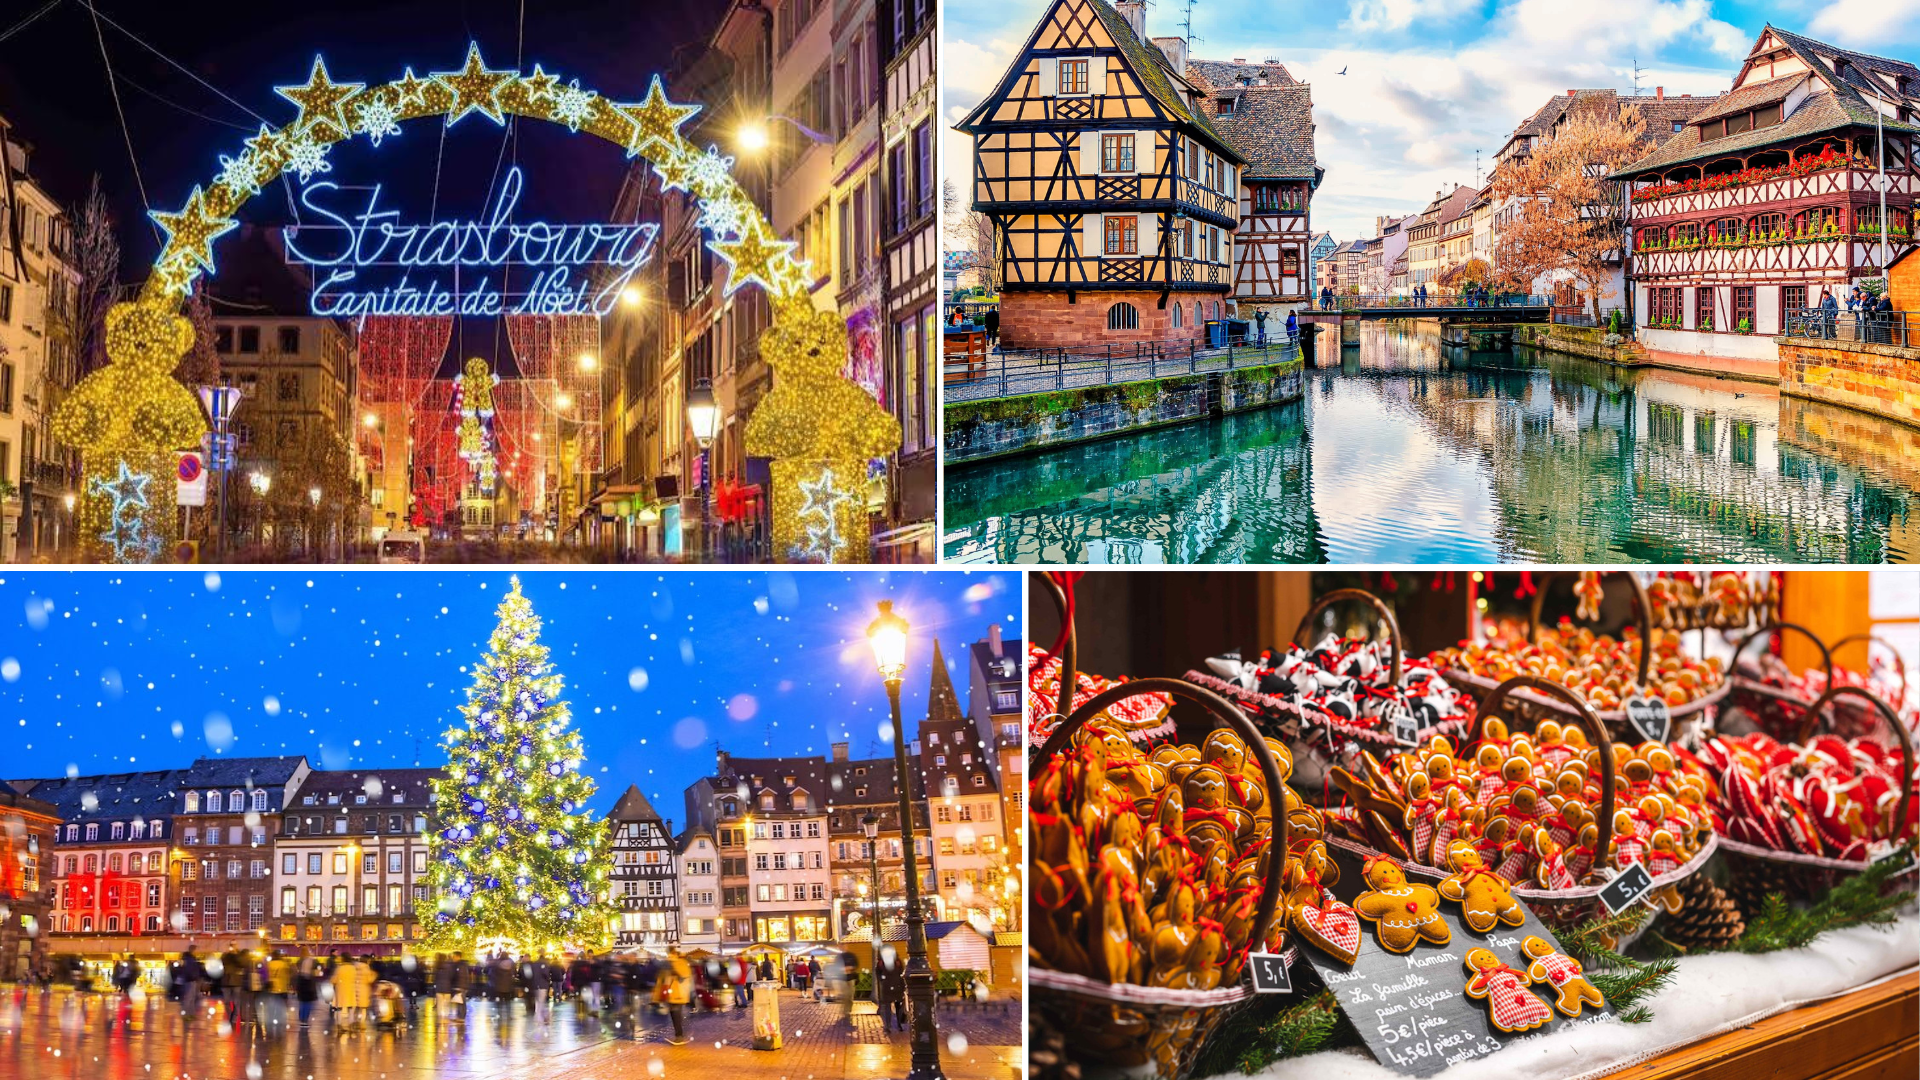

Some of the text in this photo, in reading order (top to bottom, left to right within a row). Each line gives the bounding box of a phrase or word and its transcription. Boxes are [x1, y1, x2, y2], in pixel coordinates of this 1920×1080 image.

[283, 167, 660, 315] Strasbourg
[312, 266, 591, 333] Capitale de Noël
[1486, 933, 1520, 951] Papa
[1404, 952, 1459, 970] Maman
[1348, 973, 1429, 1004] La famille
[1375, 1003, 1408, 1024] pain
[1377, 1014, 1448, 1044] 5€/pièce
[1385, 1029, 1476, 1067] 4,5€/pièce à
[1445, 1047, 1478, 1068] partir
[1475, 1041, 1492, 1054] de
[1485, 1035, 1502, 1051] 3
